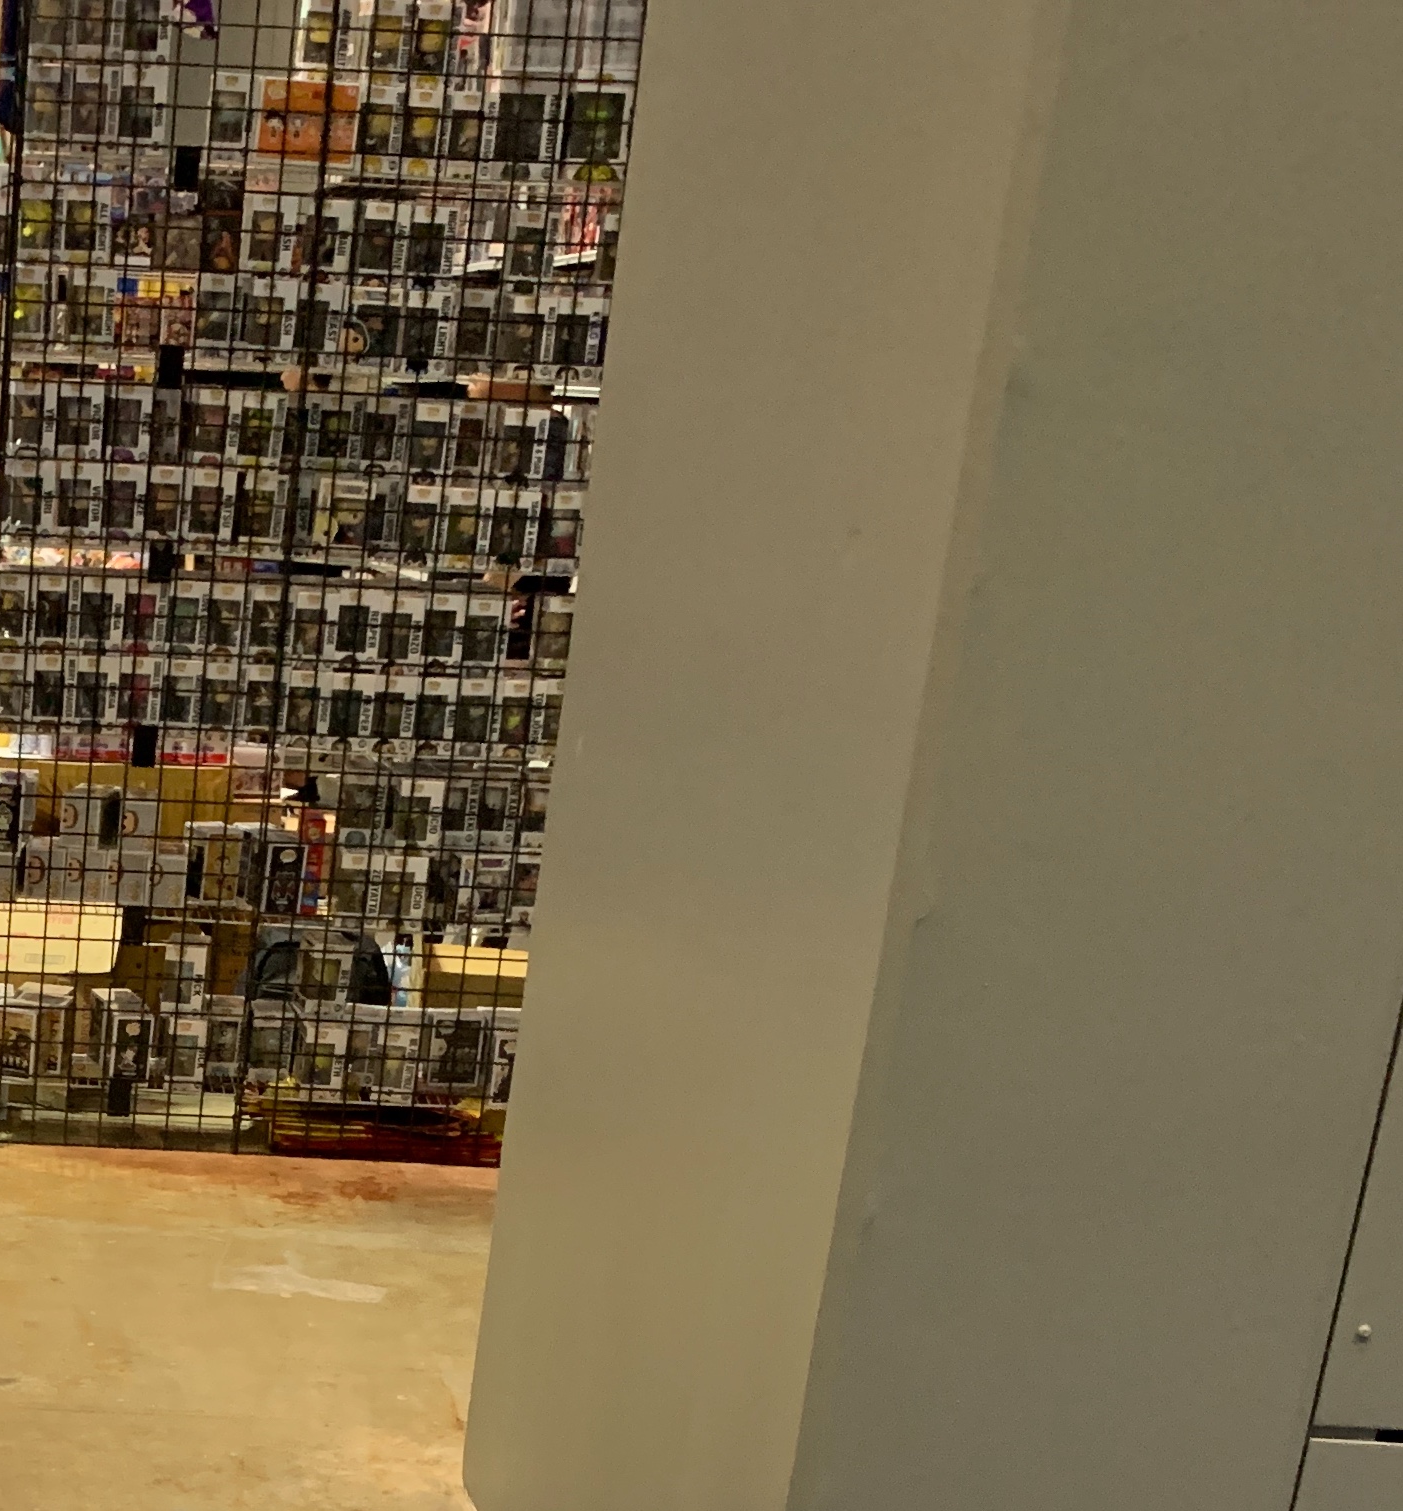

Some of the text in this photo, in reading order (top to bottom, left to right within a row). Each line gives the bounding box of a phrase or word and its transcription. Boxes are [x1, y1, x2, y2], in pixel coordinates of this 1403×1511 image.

[485, 101, 497, 136] MATER
[282, 224, 293, 252] DSH
[282, 310, 294, 336] ASH
[438, 295, 452, 321] NIGH
[326, 309, 340, 343] EAST
[402, 700, 416, 733] ANZO
[532, 692, 545, 744] TOBJÖRN
[366, 869, 383, 914] ZEYATTA
[193, 974, 205, 996] RCK
[332, 1055, 344, 1078] ETH
